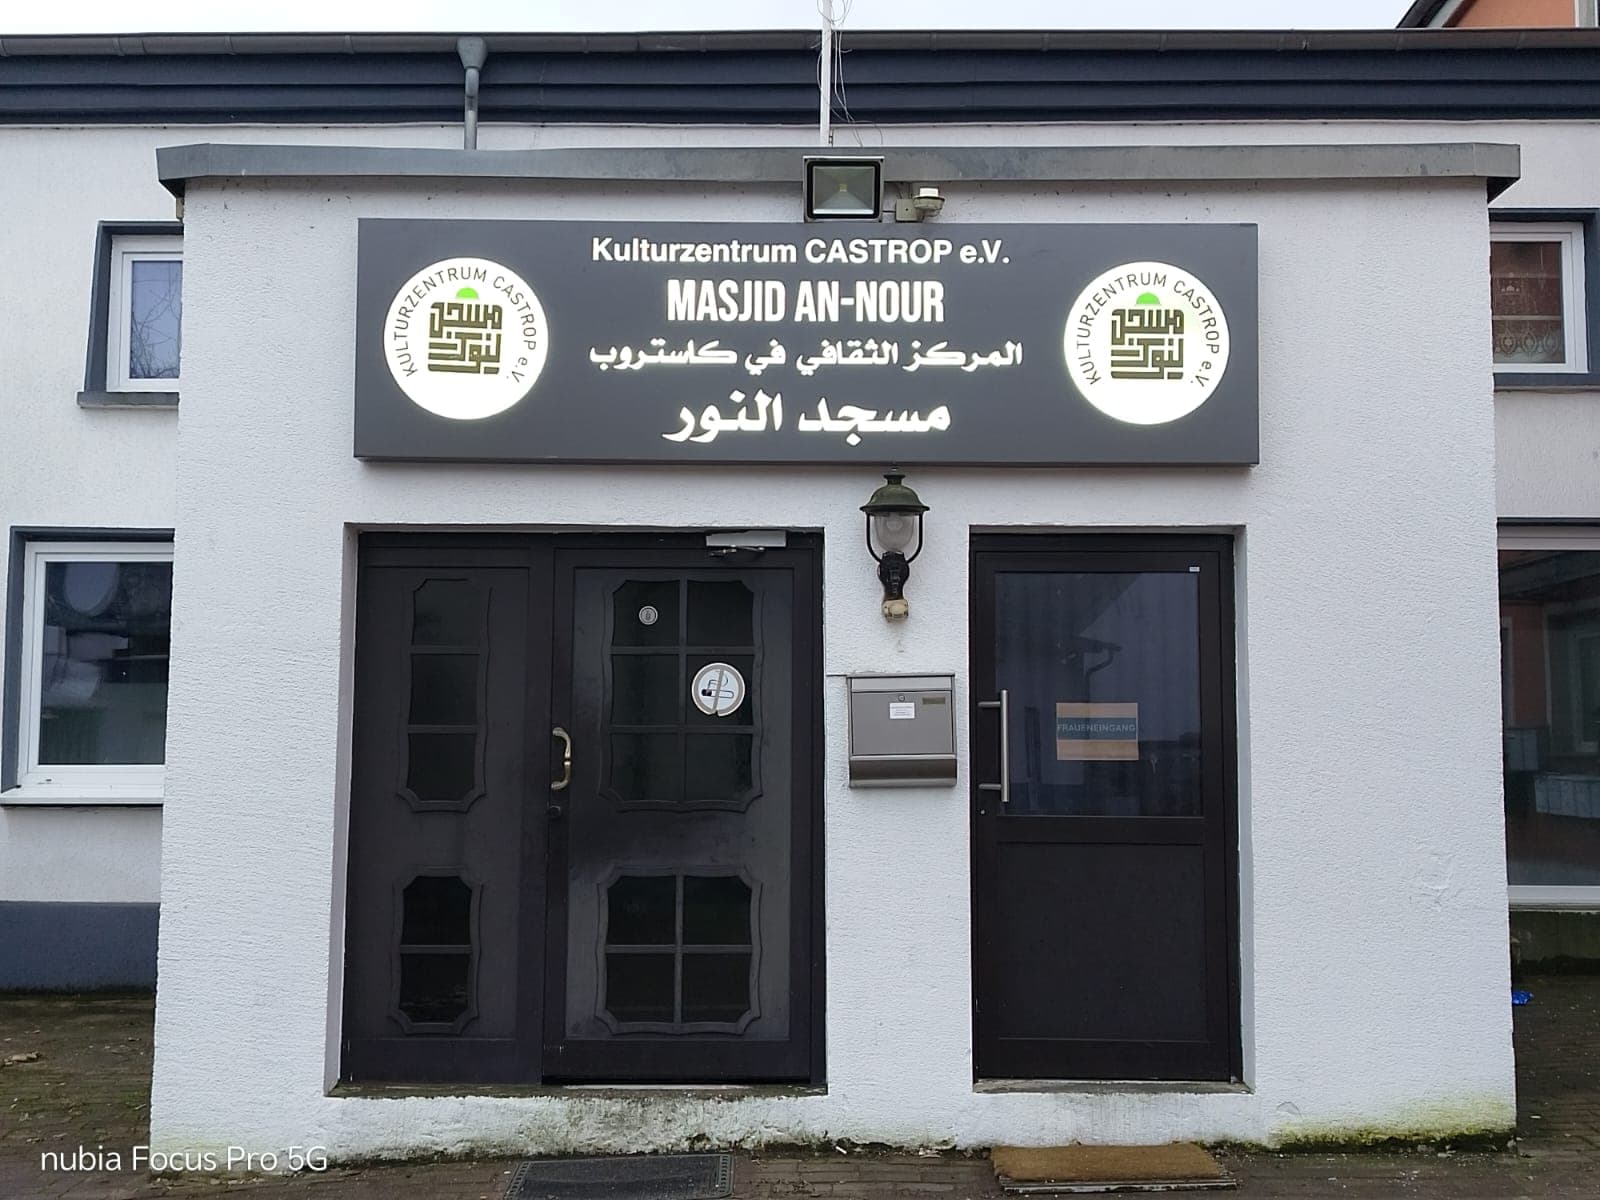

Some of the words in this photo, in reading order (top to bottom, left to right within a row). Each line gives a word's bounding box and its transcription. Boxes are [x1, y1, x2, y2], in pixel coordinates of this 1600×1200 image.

[592, 237, 797, 264] Kulturzentrum
[804, 238, 953, 265] CASTROP
[959, 239, 1010, 264] e.V.
[493, 276, 537, 351] CASTROP
[667, 279, 786, 323] MASJID
[793, 280, 945, 323] AN-NOUR
[1173, 280, 1220, 354] CASTROP
[393, 266, 488, 377] KULTURZENTRUM
[1076, 272, 1168, 385] KULTURZENTRUM
[506, 356, 529, 384] e.V.
[589, 337, 738, 371] كاستروب
[744, 339, 787, 376] في
[795, 338, 899, 377] الثقافي
[902, 340, 1023, 373] المركز
[1190, 360, 1213, 388] e.V.
[662, 389, 783, 443] النور
[797, 396, 951, 446] مسجد
[1056, 723, 1136, 733] FRAUENEINGANG
